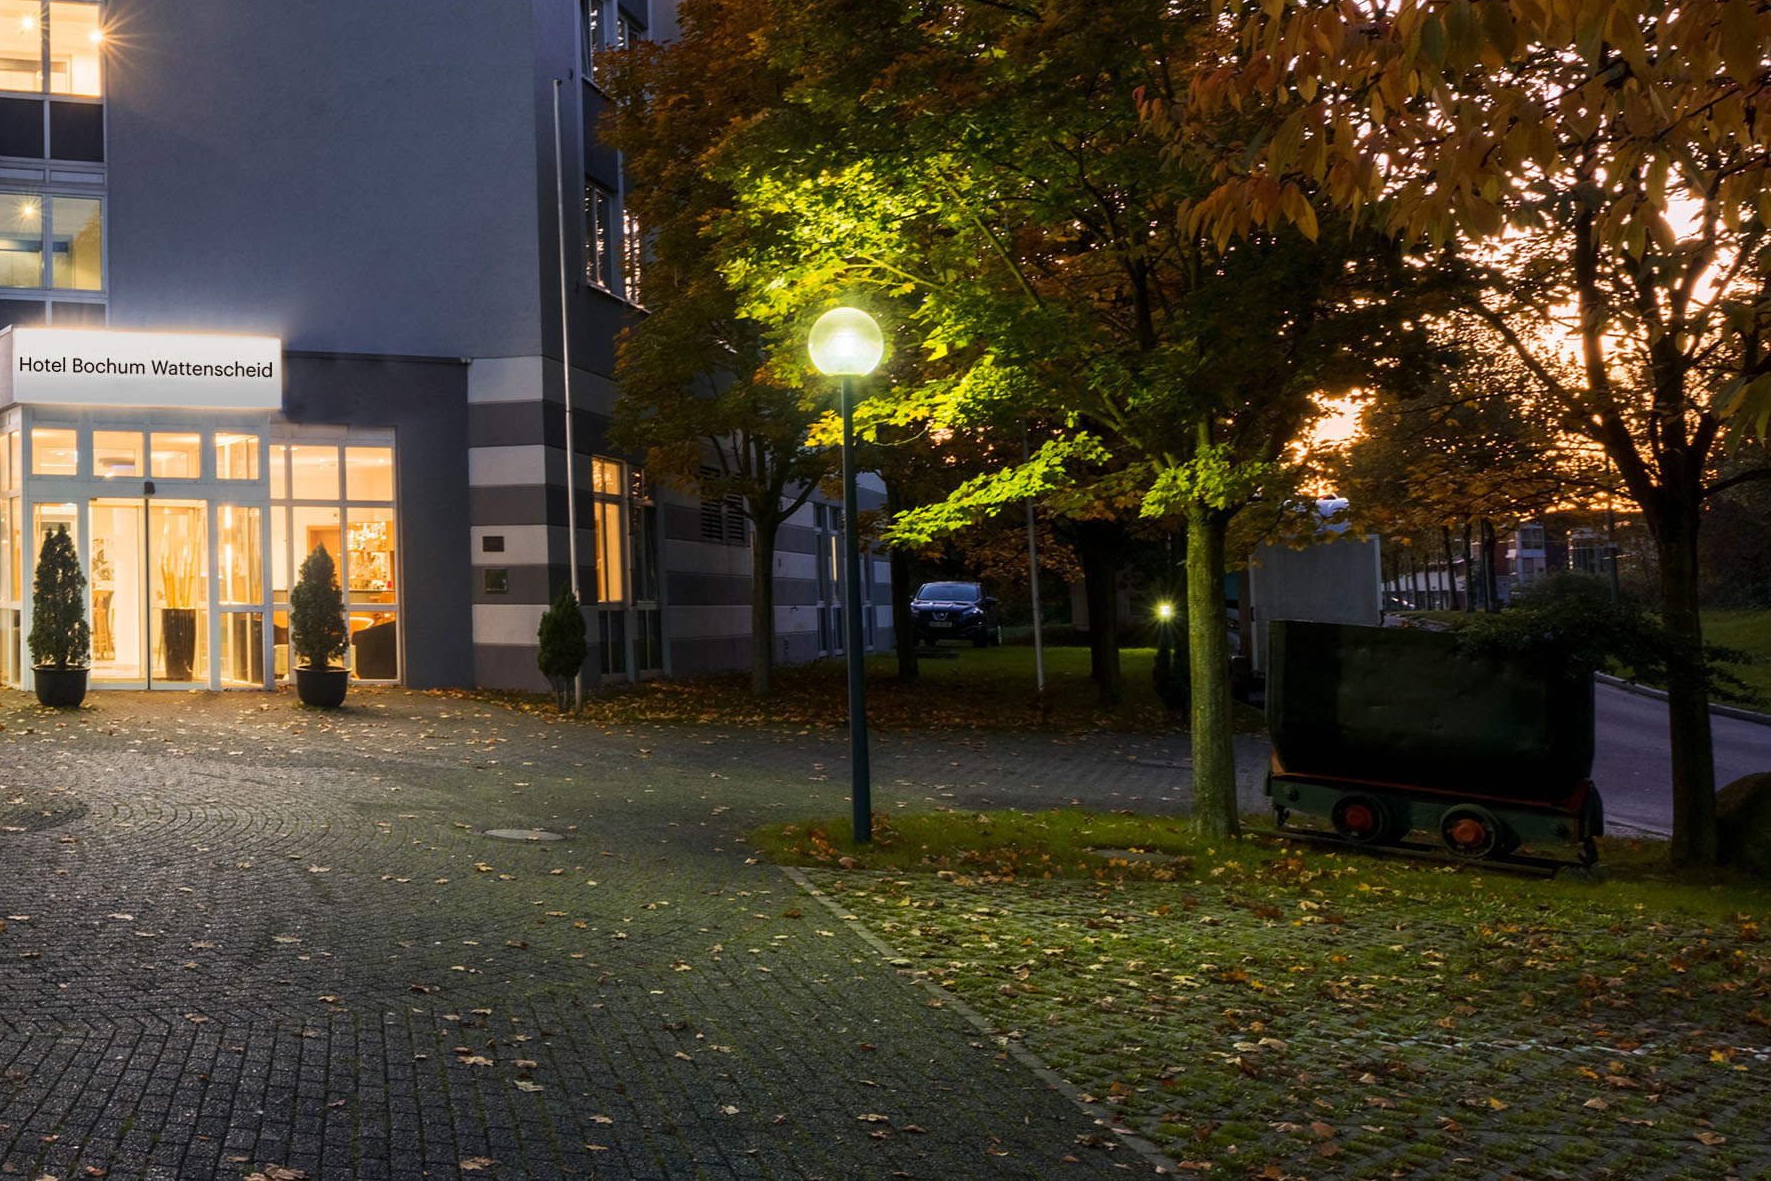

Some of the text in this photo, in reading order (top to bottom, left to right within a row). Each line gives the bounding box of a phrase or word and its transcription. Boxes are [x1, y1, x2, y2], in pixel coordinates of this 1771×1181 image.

[19, 356, 273, 378] Hotel Bochum Wattenscheid
